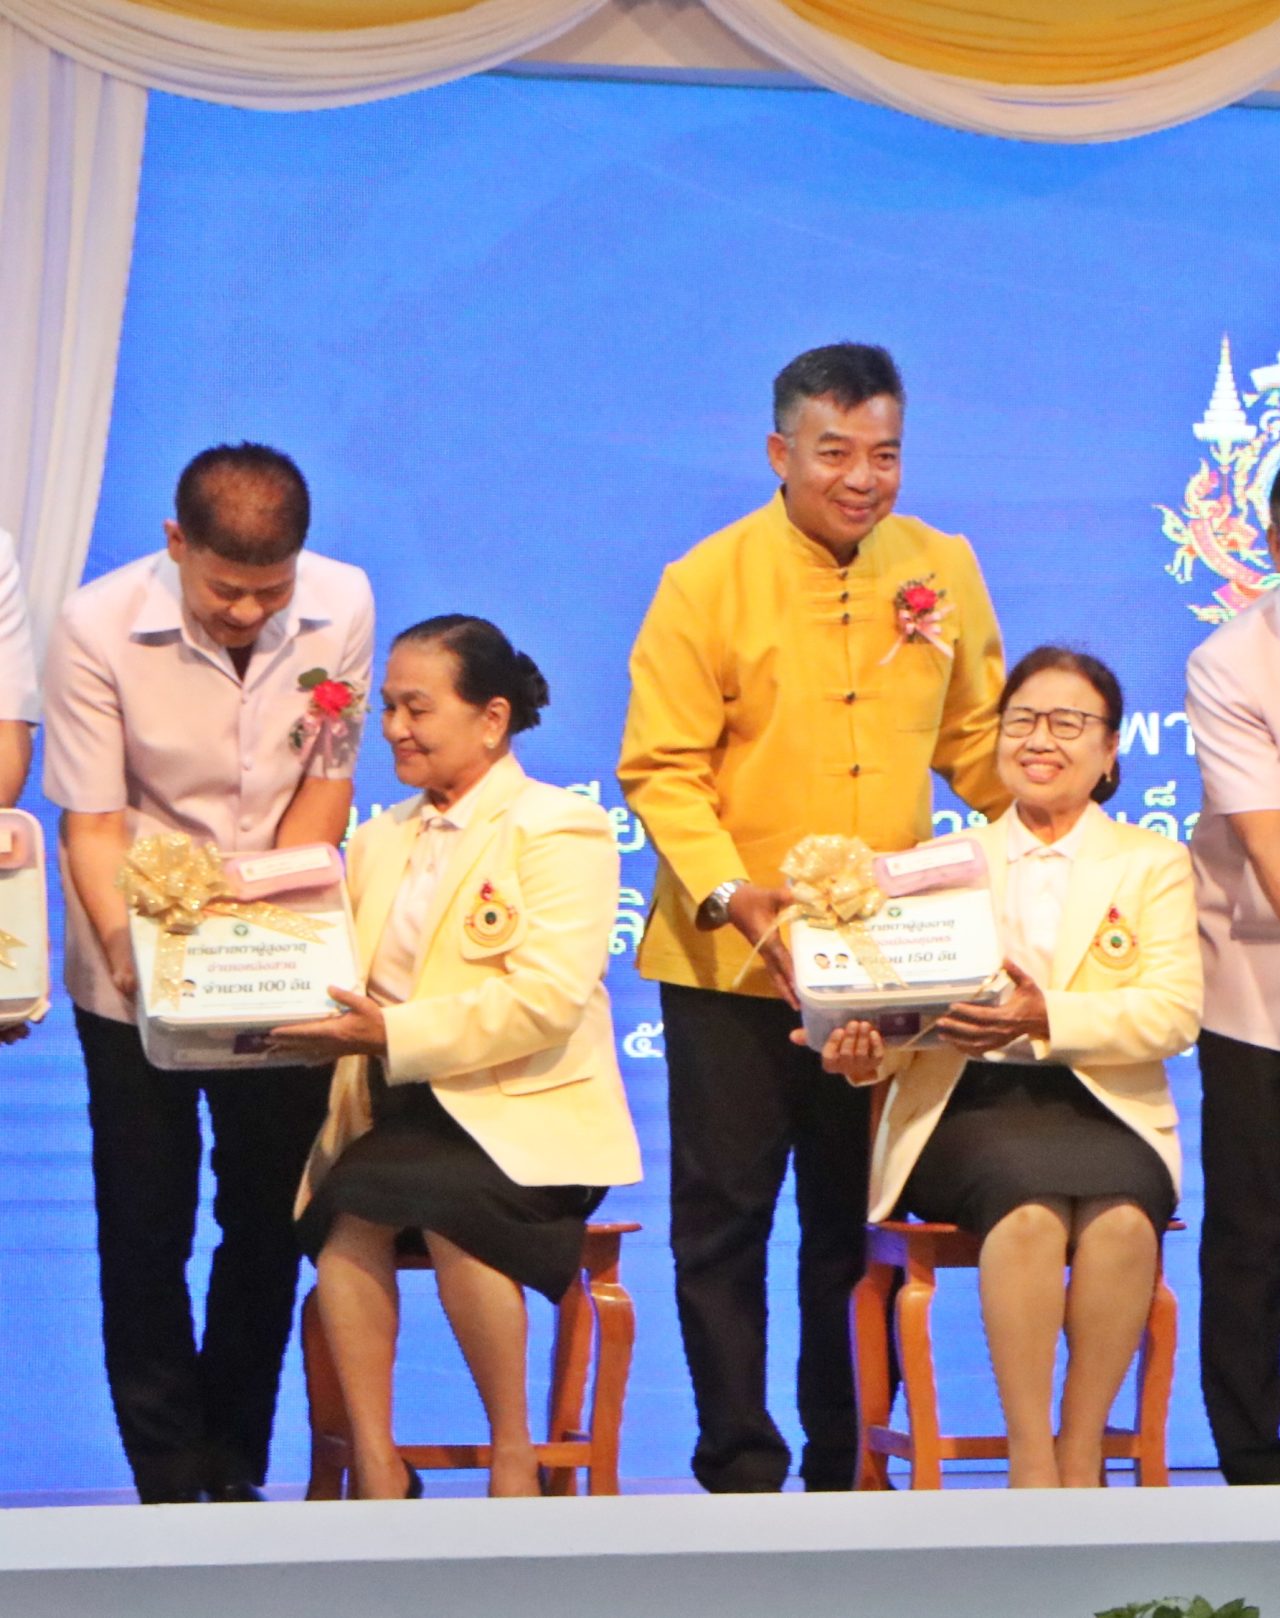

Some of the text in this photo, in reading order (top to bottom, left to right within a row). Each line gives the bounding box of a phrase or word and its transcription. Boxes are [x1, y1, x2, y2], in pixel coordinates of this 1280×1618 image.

[908, 951, 933, 963] 150
[203, 980, 254, 994] จำนวน
[258, 979, 287, 992] 100
